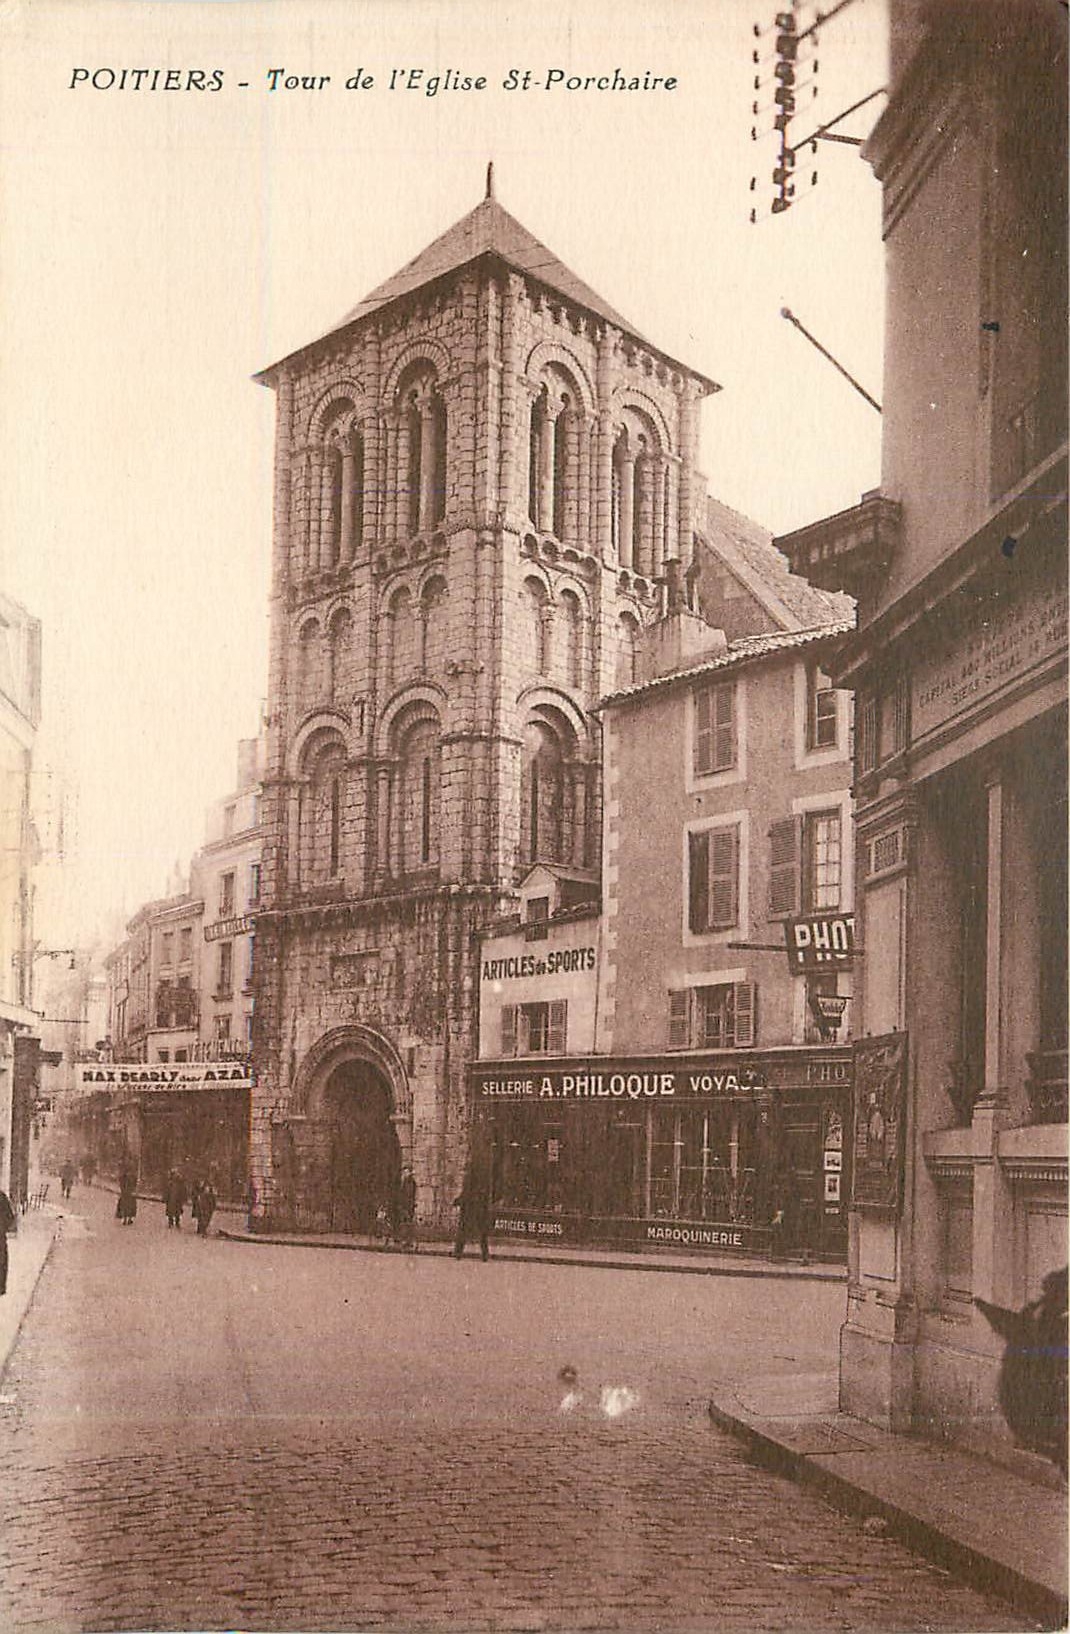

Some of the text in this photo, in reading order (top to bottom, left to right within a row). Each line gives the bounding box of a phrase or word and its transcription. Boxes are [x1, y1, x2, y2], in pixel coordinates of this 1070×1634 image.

[482, 955, 535, 981] ARTICLES
[547, 947, 595, 974] SPORTS
[83, 1071, 115, 1082] MAX
[120, 1071, 179, 1082] DEARLY
[482, 1080, 533, 1096] SELLERIE
[647, 1226, 743, 1246] MAROQUINERIE
